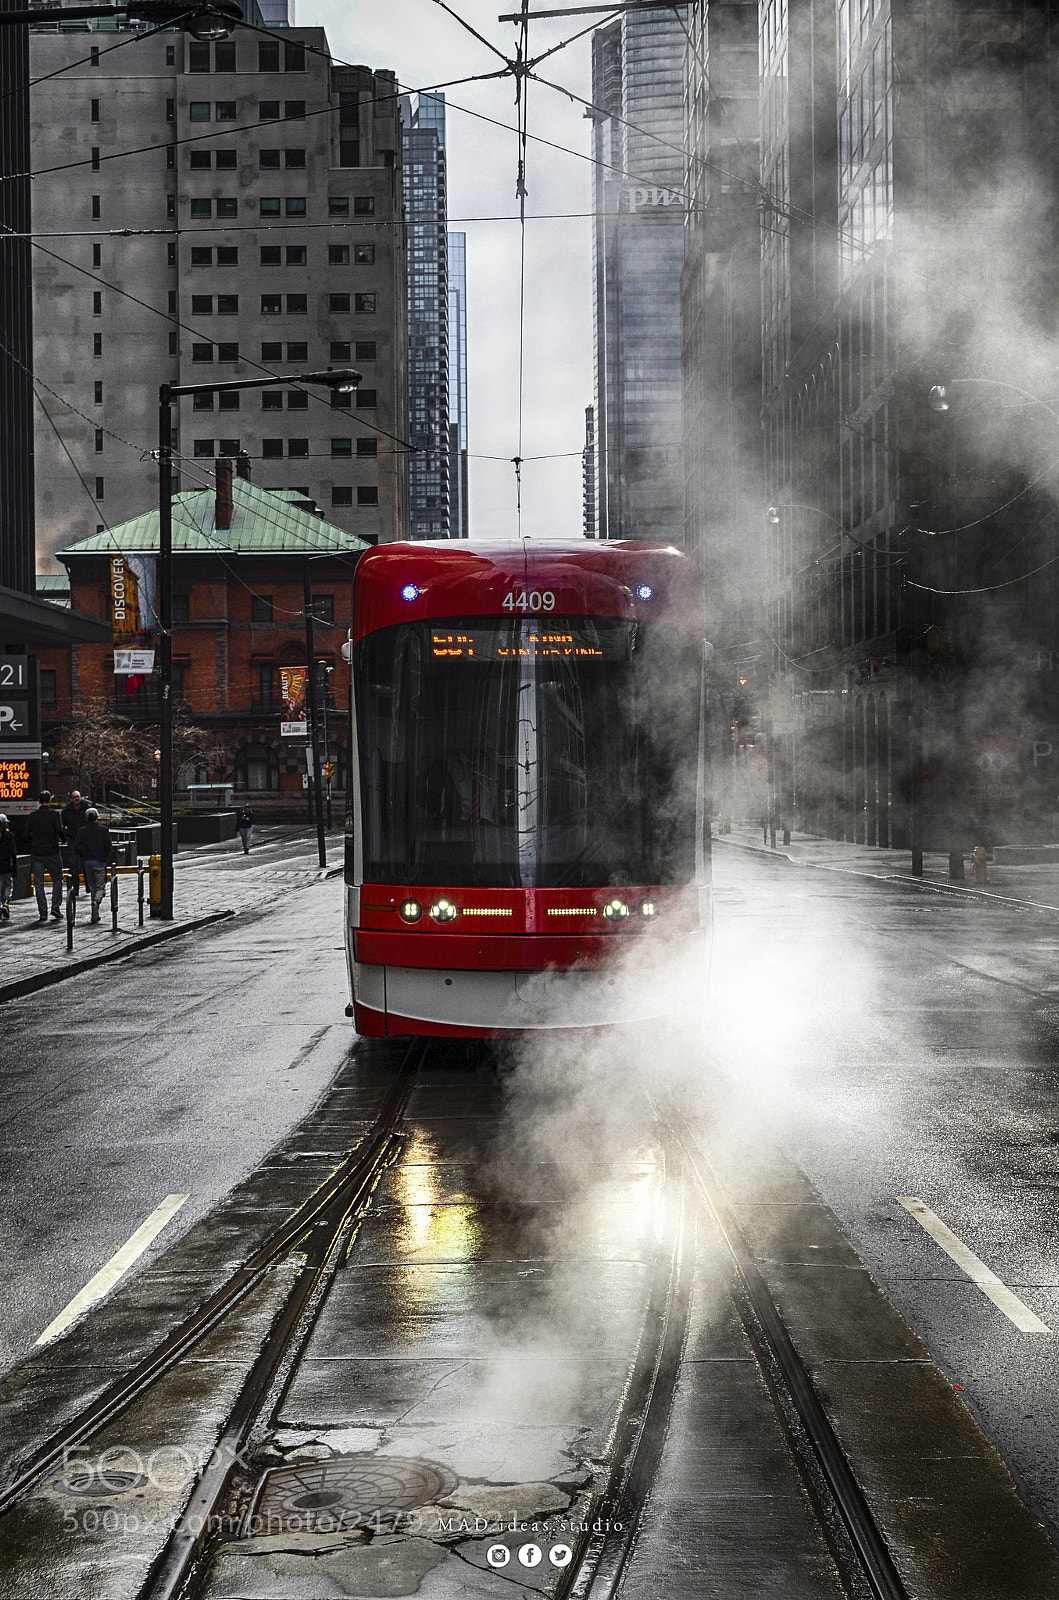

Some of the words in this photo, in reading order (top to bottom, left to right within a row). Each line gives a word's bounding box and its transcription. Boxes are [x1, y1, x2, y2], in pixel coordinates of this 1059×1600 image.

[113, 558, 126, 620] DISCOVER
[502, 591, 555, 611] 4409
[1, 665, 22, 685] 21
[281, 671, 289, 699] BEAUTY
[7, 770, 30, 780] Rate
